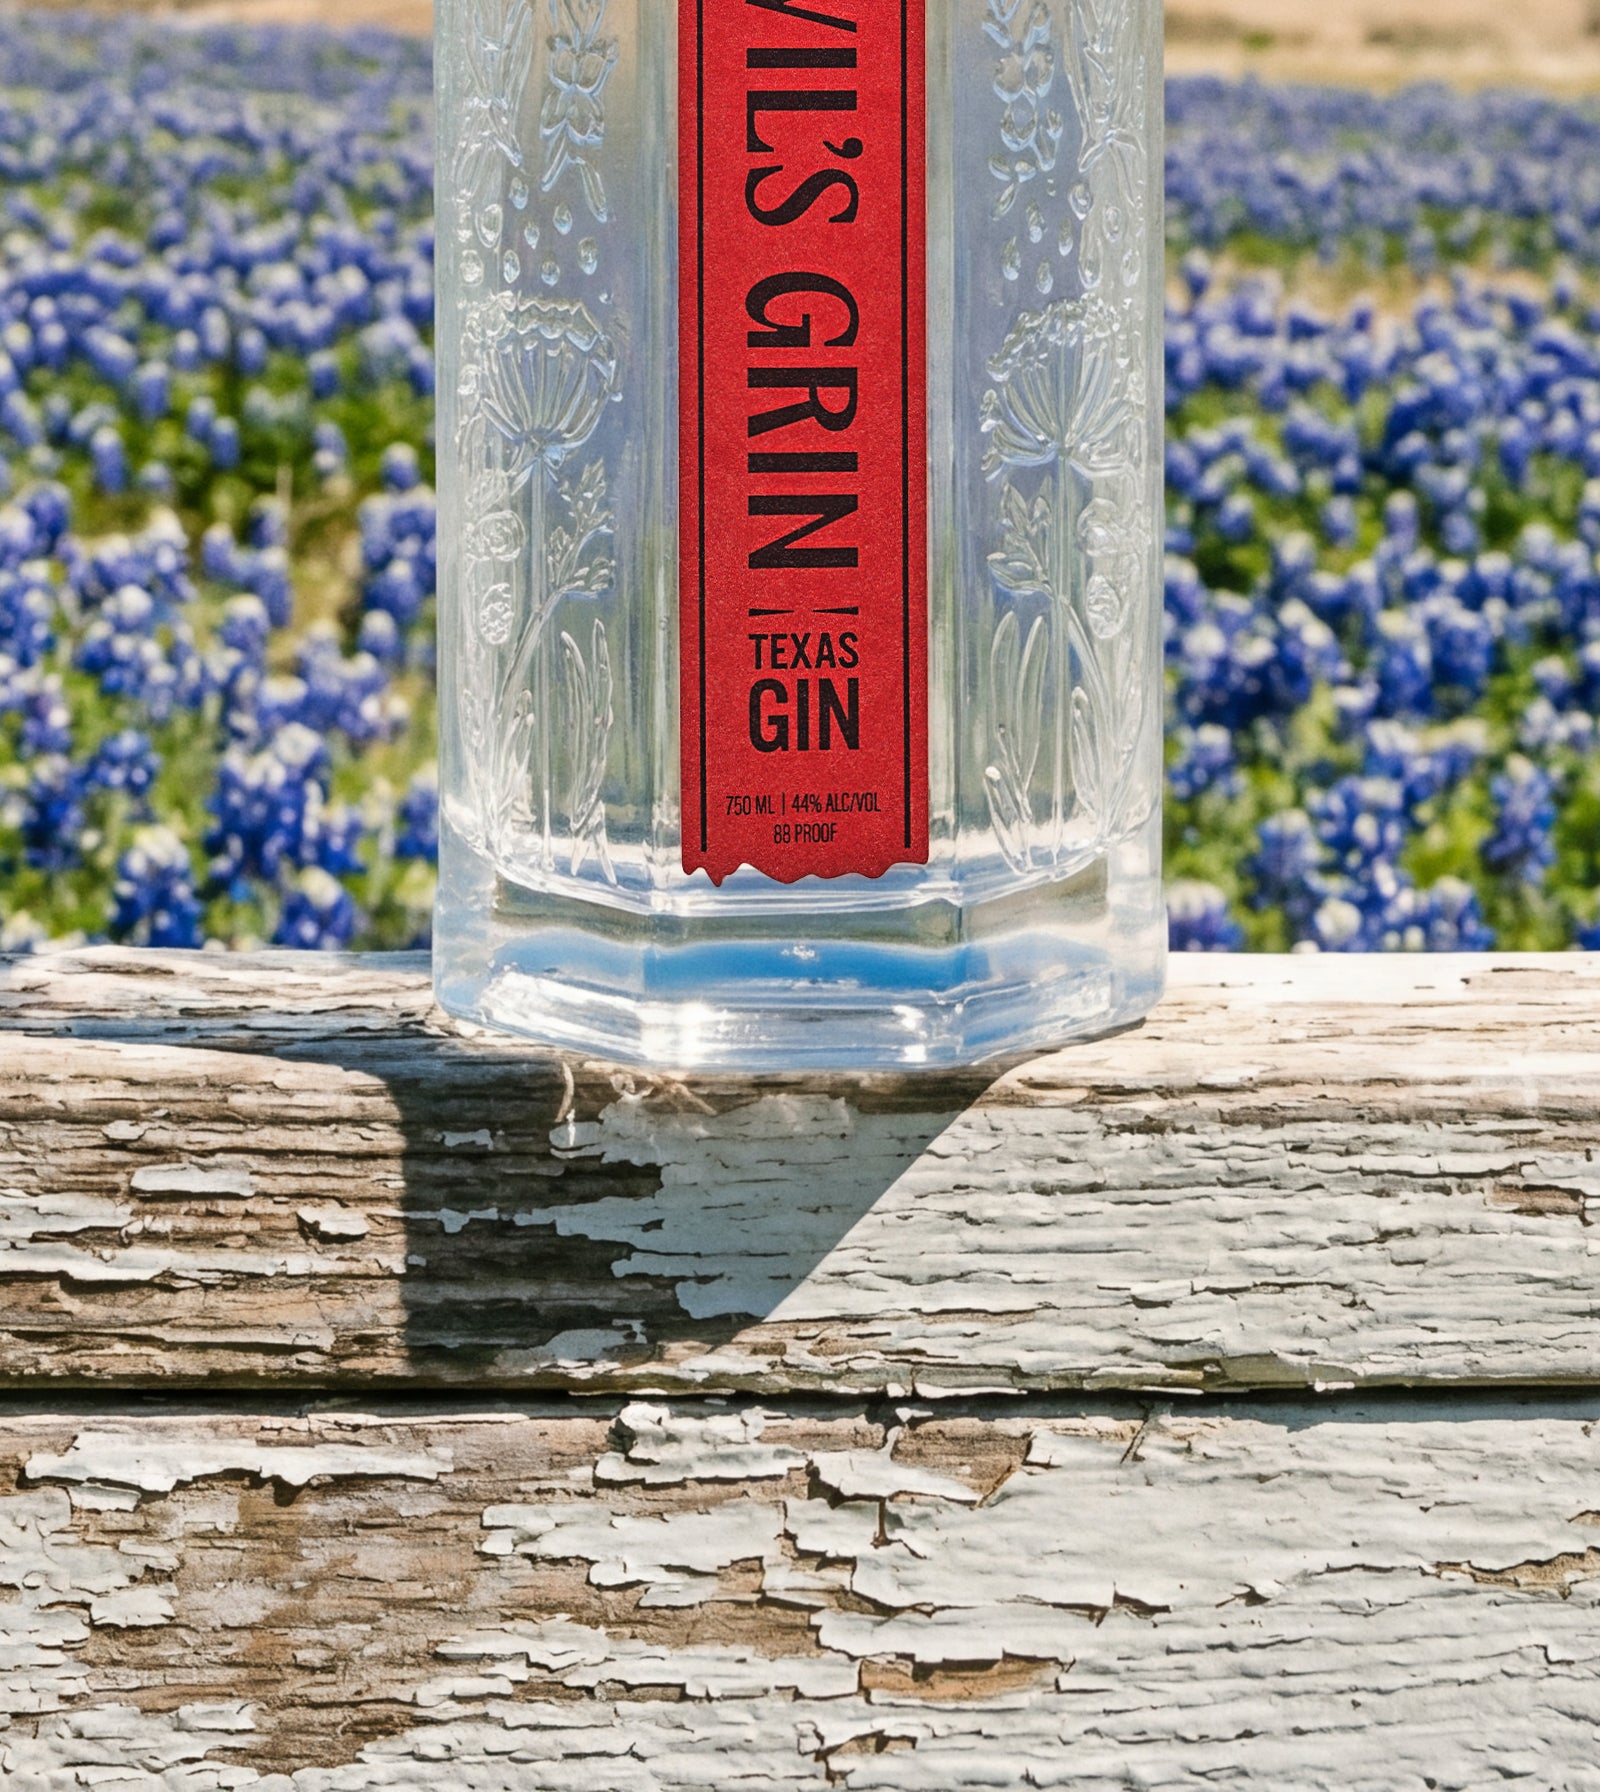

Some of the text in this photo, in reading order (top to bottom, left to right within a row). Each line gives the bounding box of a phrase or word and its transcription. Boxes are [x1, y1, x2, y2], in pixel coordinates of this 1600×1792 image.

[745, 271, 859, 569] GRIN
[748, 632, 860, 670] TEXAS
[749, 677, 860, 753] GIN
[726, 795, 750, 816] 750
[755, 794, 775, 815] ML
[791, 793, 822, 813] 44%
[825, 791, 882, 813] ALC/VOL
[773, 822, 838, 844] 88 PROOF
